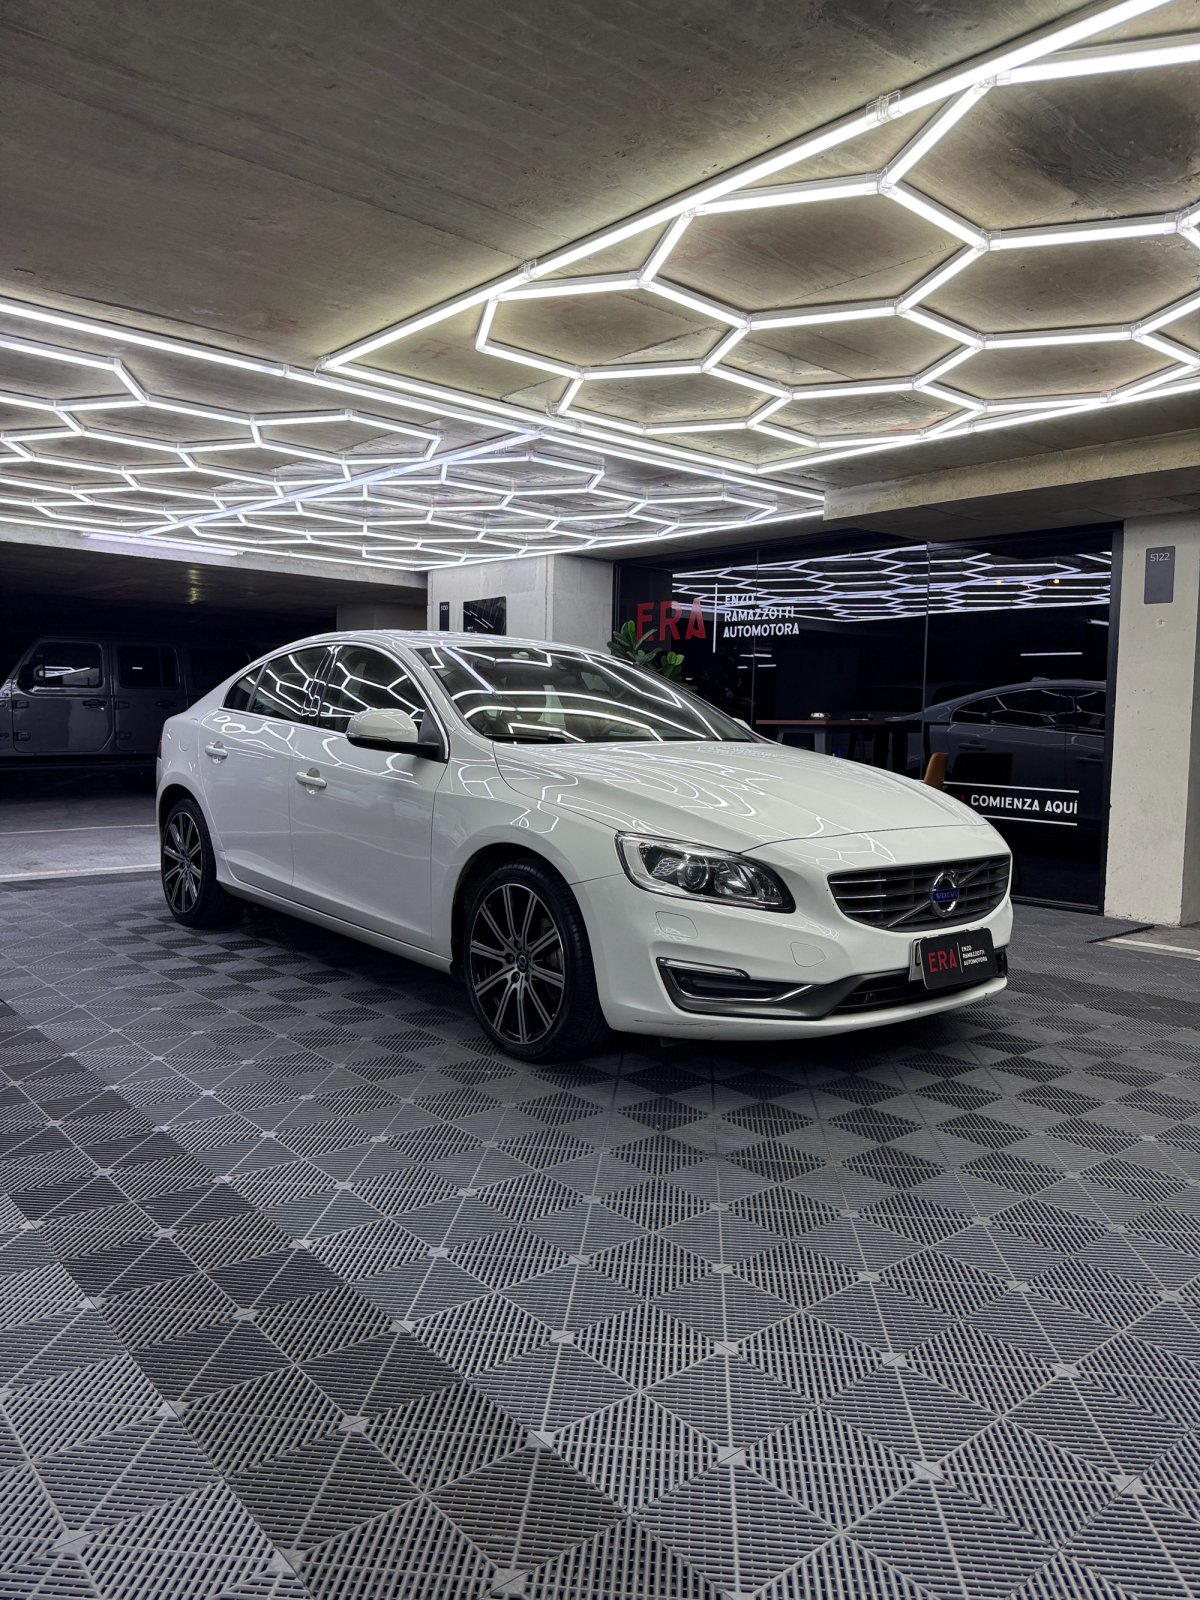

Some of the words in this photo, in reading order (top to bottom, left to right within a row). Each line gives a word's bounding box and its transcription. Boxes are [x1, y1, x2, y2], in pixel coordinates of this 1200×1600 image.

[1150, 553, 1170, 561] 5122
[724, 593, 755, 606] ENZO
[636, 598, 707, 641] ERA
[724, 606, 795, 622] RAMAZZOTTI
[723, 622, 800, 638] AUTOMOTORA
[970, 794, 1040, 811] COMIENZA
[1045, 800, 1078, 814] AQUÍ
[928, 949, 958, 973] ERA
[963, 956, 988, 966] AUTOMOTORA
